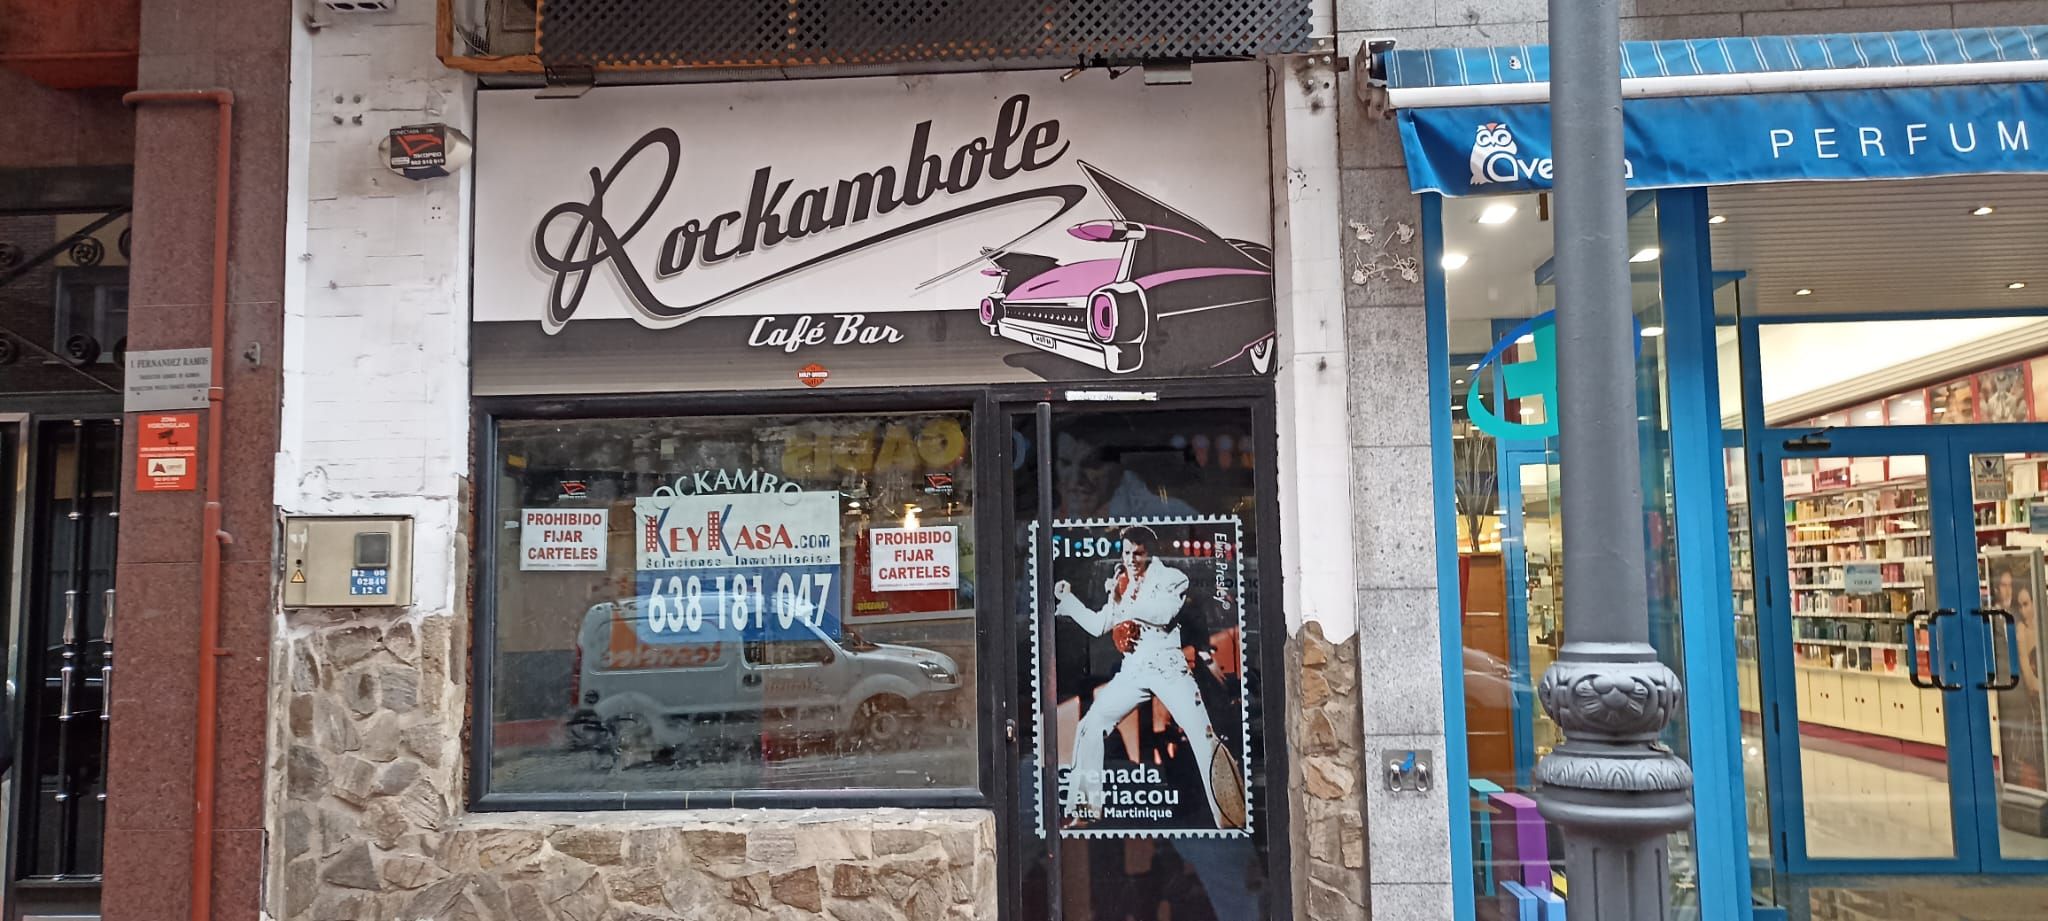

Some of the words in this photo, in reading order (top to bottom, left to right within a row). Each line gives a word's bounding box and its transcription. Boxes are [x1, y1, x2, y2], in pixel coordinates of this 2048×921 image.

[1769, 120, 2030, 159] PERFUM
[533, 94, 1080, 324] Rockambole
[748, 315, 827, 353] Café
[833, 313, 905, 345] Bar
[651, 467, 804, 508] OCKAMBO
[527, 513, 602, 526] PROHIBIDO
[543, 530, 583, 543] FIJAR
[875, 530, 952, 546] PROHIBIDO
[1214, 532, 1228, 559] Elvis
[527, 547, 599, 560] CARTELES
[894, 548, 934, 562] FIJAR
[1052, 536, 1112, 560] $1.50
[878, 565, 951, 580] CARTELES
[648, 575, 702, 633] 638
[715, 573, 763, 631] 181
[776, 572, 832, 630] 047
[1104, 807, 1173, 821] Martinique
